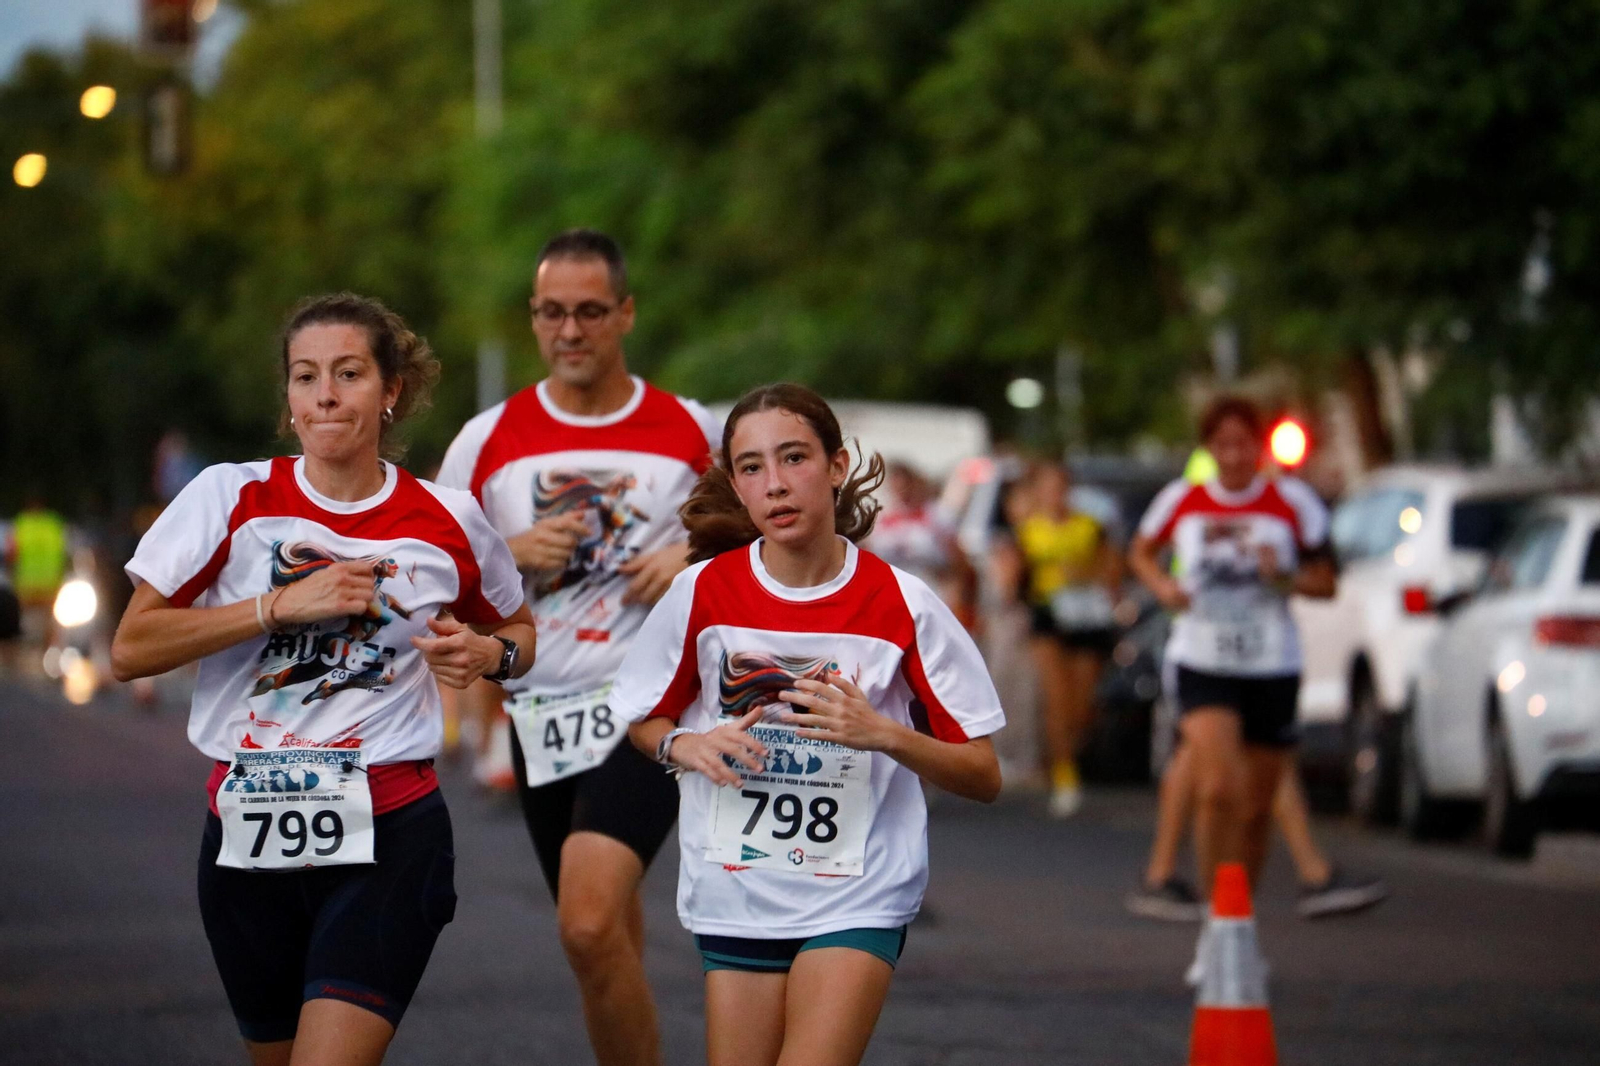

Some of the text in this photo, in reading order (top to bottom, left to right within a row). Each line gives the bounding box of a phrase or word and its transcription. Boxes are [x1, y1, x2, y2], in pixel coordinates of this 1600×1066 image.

[543, 704, 615, 752] 478
[270, 750, 341, 758] PROVINCIAL
[749, 774, 769, 782] CARRERA
[784, 778, 799, 786] MUJER
[242, 809, 344, 858] 799
[741, 789, 839, 843] 798
